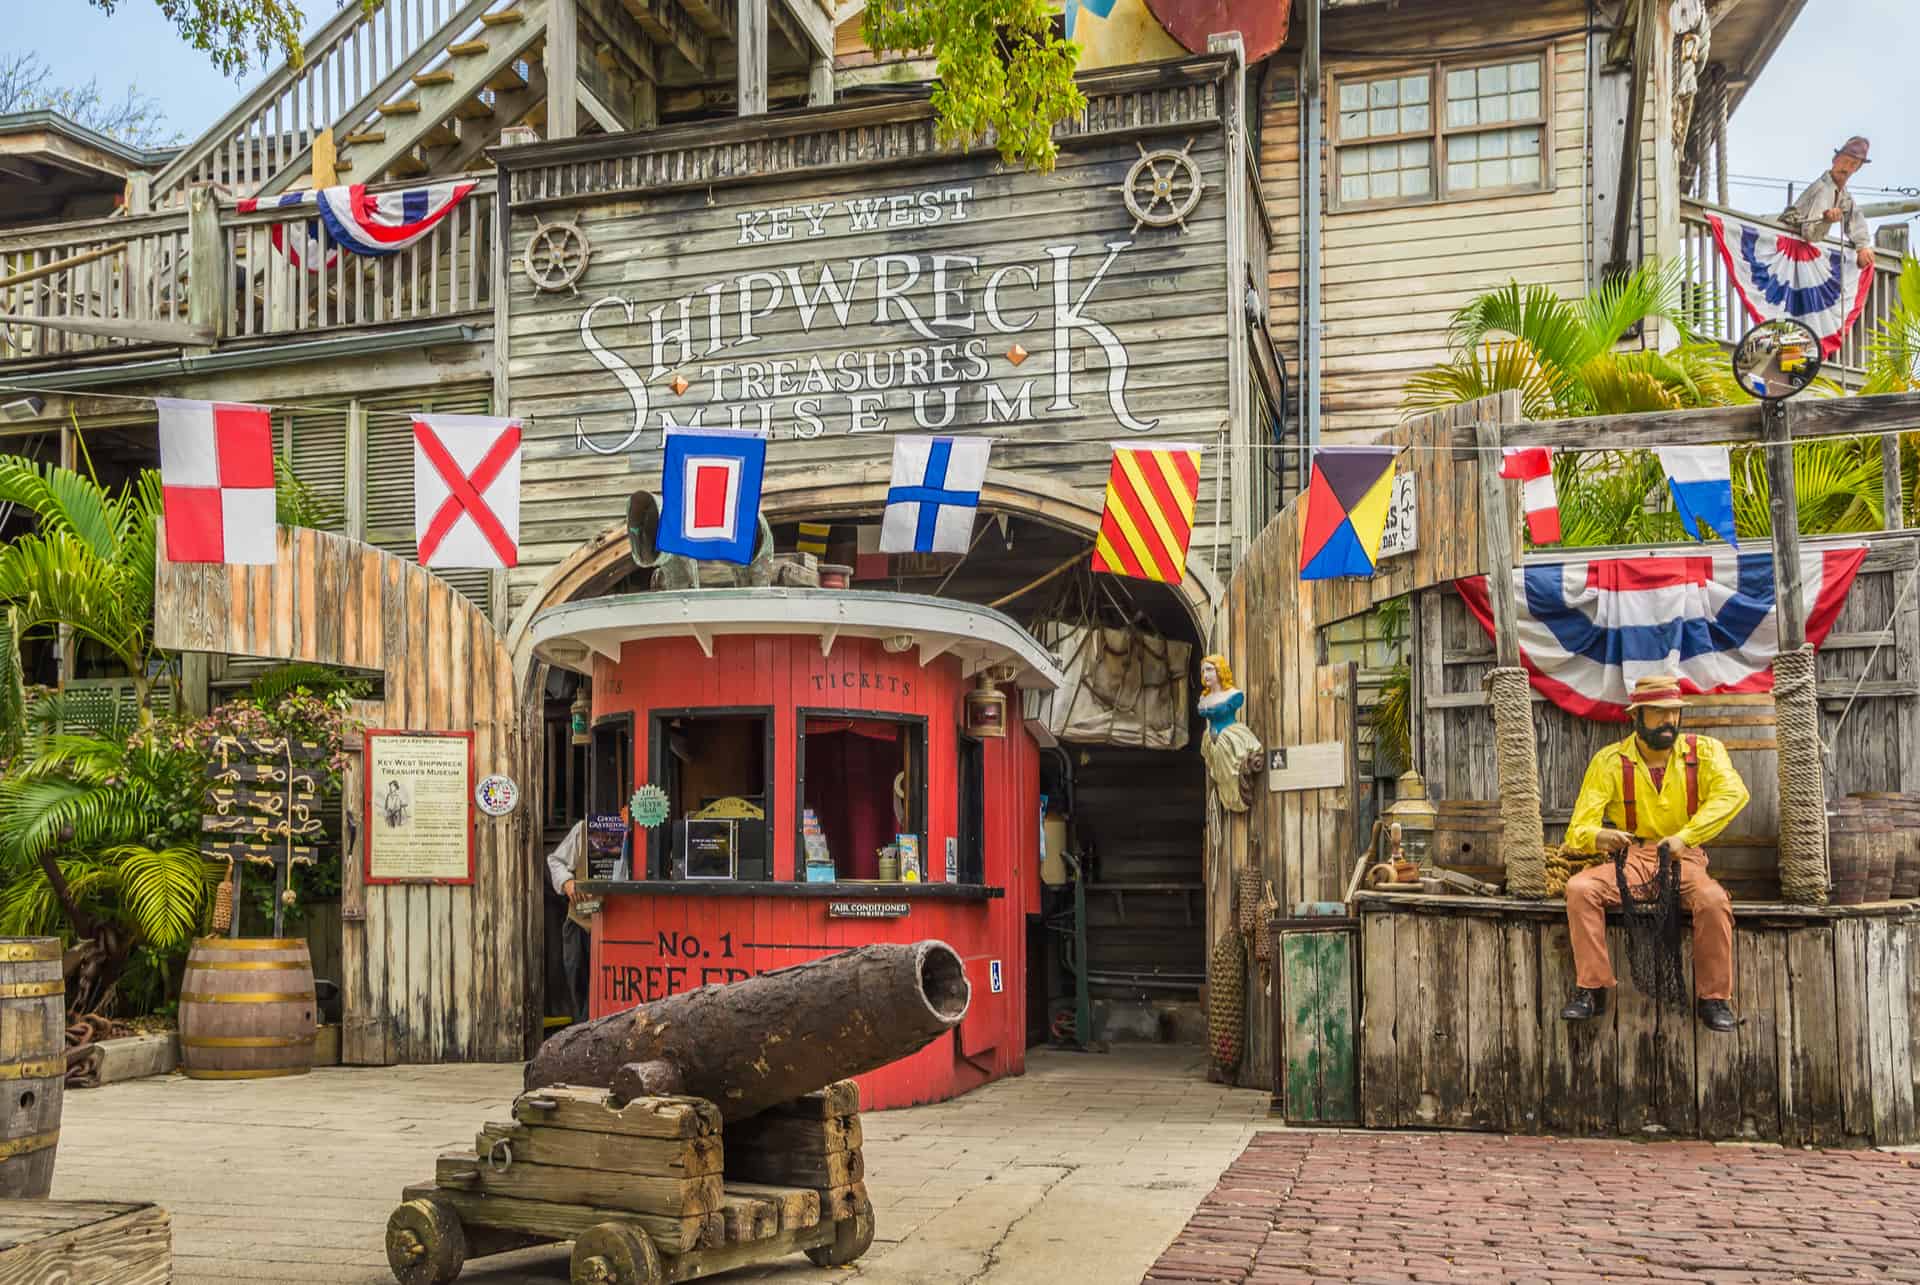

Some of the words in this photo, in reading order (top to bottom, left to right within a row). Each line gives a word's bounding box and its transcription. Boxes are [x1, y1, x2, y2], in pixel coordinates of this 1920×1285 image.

[736, 203, 834, 244] KEY
[843, 187, 974, 232] WEST
[575, 240, 1159, 455] SHIPWRECK
[701, 339, 991, 402] TREASURES
[811, 672, 911, 697] TICKETS
[377, 759, 394, 767] KEY
[395, 759, 417, 767] WEST
[834, 903, 849, 912] AIR
[850, 903, 907, 912] CONDITIONED
[719, 931, 735, 958] 1
[602, 964, 687, 1003] THREE
